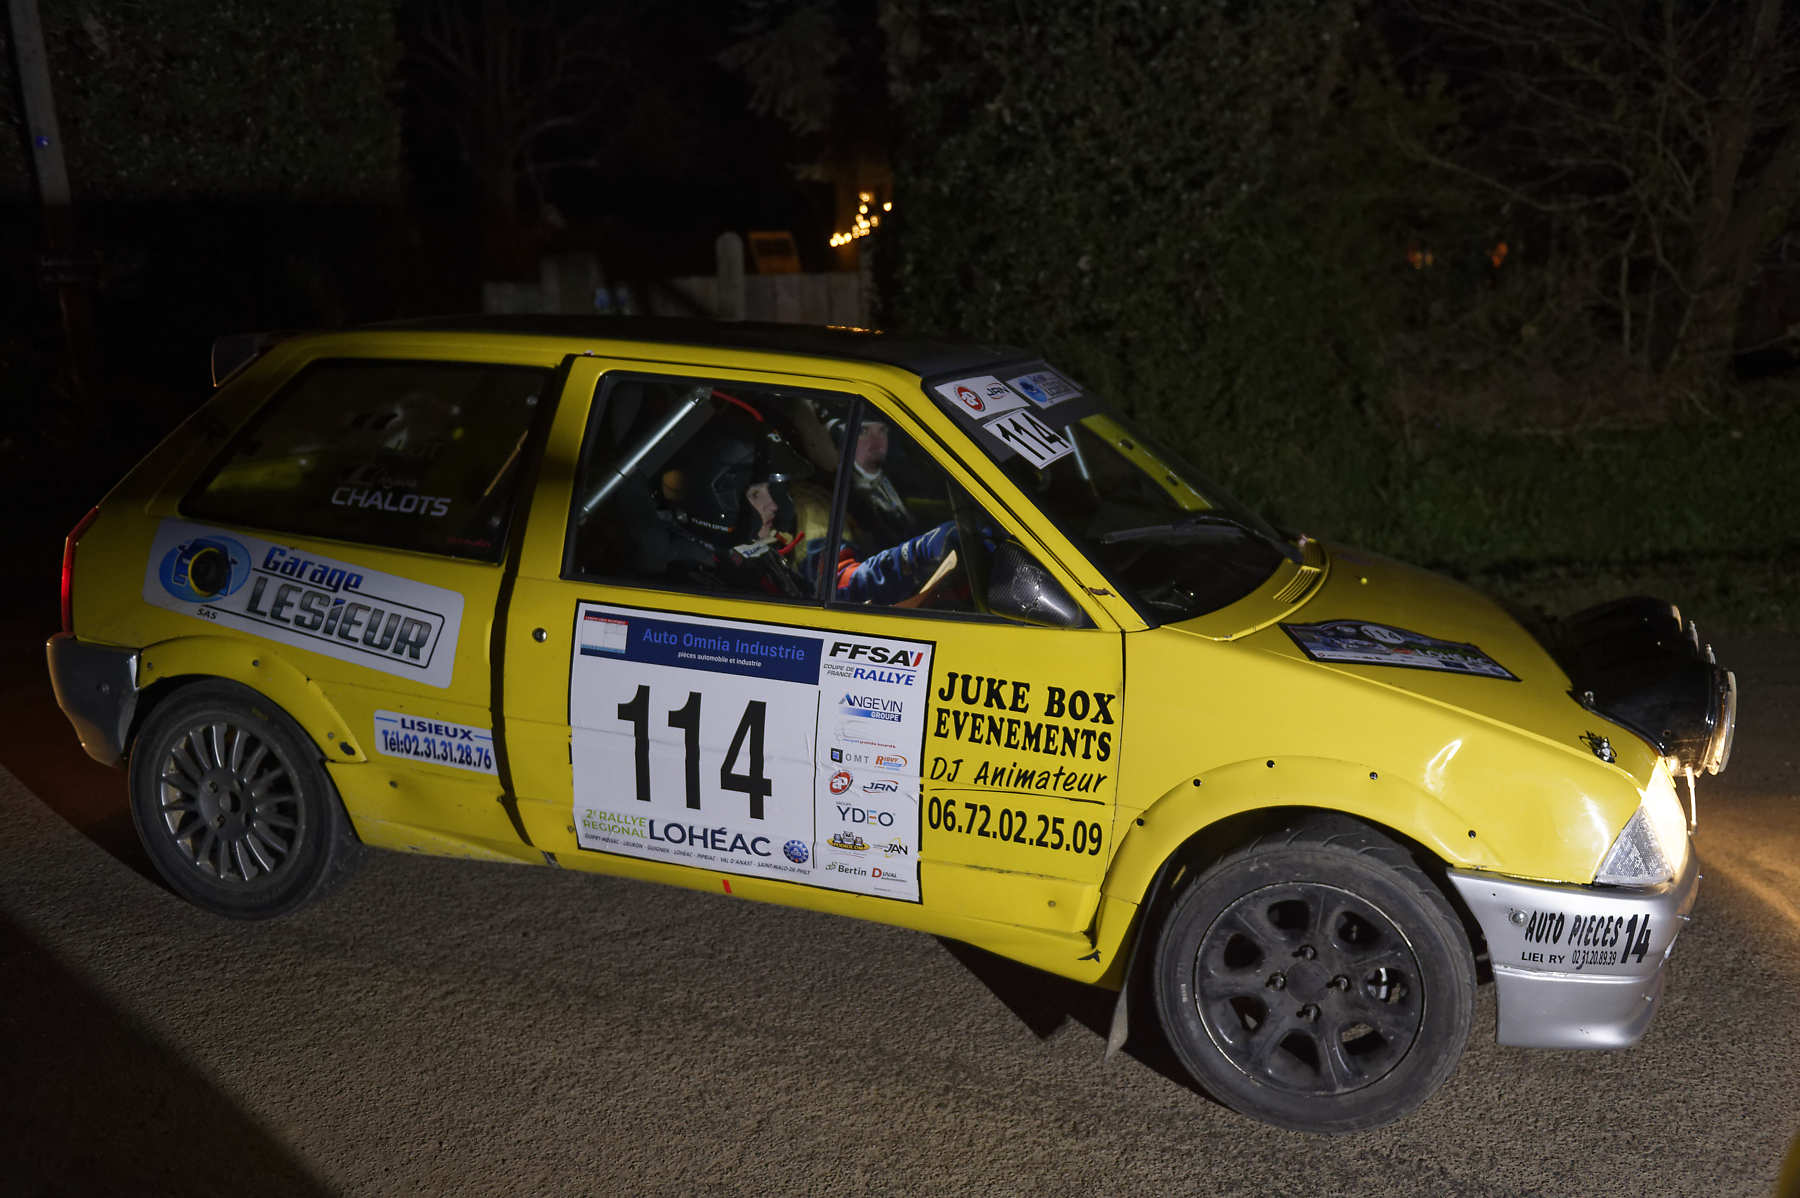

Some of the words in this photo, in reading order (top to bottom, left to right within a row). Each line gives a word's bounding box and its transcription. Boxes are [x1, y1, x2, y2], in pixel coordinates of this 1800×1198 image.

[996, 412, 1070, 461] 114
[331, 487, 453, 517] CHALOTS
[262, 546, 364, 593] Garage
[197, 607, 219, 620] SAS
[642, 628, 678, 645] Auto
[682, 632, 731, 652] Omnia
[735, 639, 806, 661] Industrie
[829, 641, 911, 667] FFSA
[697, 653, 729, 664] automobile
[736, 657, 763, 668] industrie
[826, 670, 852, 678] FRANCE
[853, 667, 916, 686] RALLYE
[938, 672, 1030, 713] JUKE
[1044, 686, 1116, 724] BOX
[401, 718, 474, 741] LISIEUX
[871, 711, 900, 720] GROUPE
[934, 708, 1111, 761] EVENEMENTS
[617, 683, 773, 821] 114
[930, 757, 963, 782] DJ
[974, 761, 1107, 792] Animateur
[599, 811, 648, 827] RALLYE
[836, 805, 894, 826] YDEO
[928, 796, 1102, 855] 06.72.02.25.09
[649, 819, 772, 857] LOHÉAC
[884, 843, 908, 855] JAN
[838, 864, 867, 877] Bertin
[1525, 910, 1565, 944] AUTO
[1568, 915, 1623, 947] PIECES
[1620, 914, 1651, 964] 14
